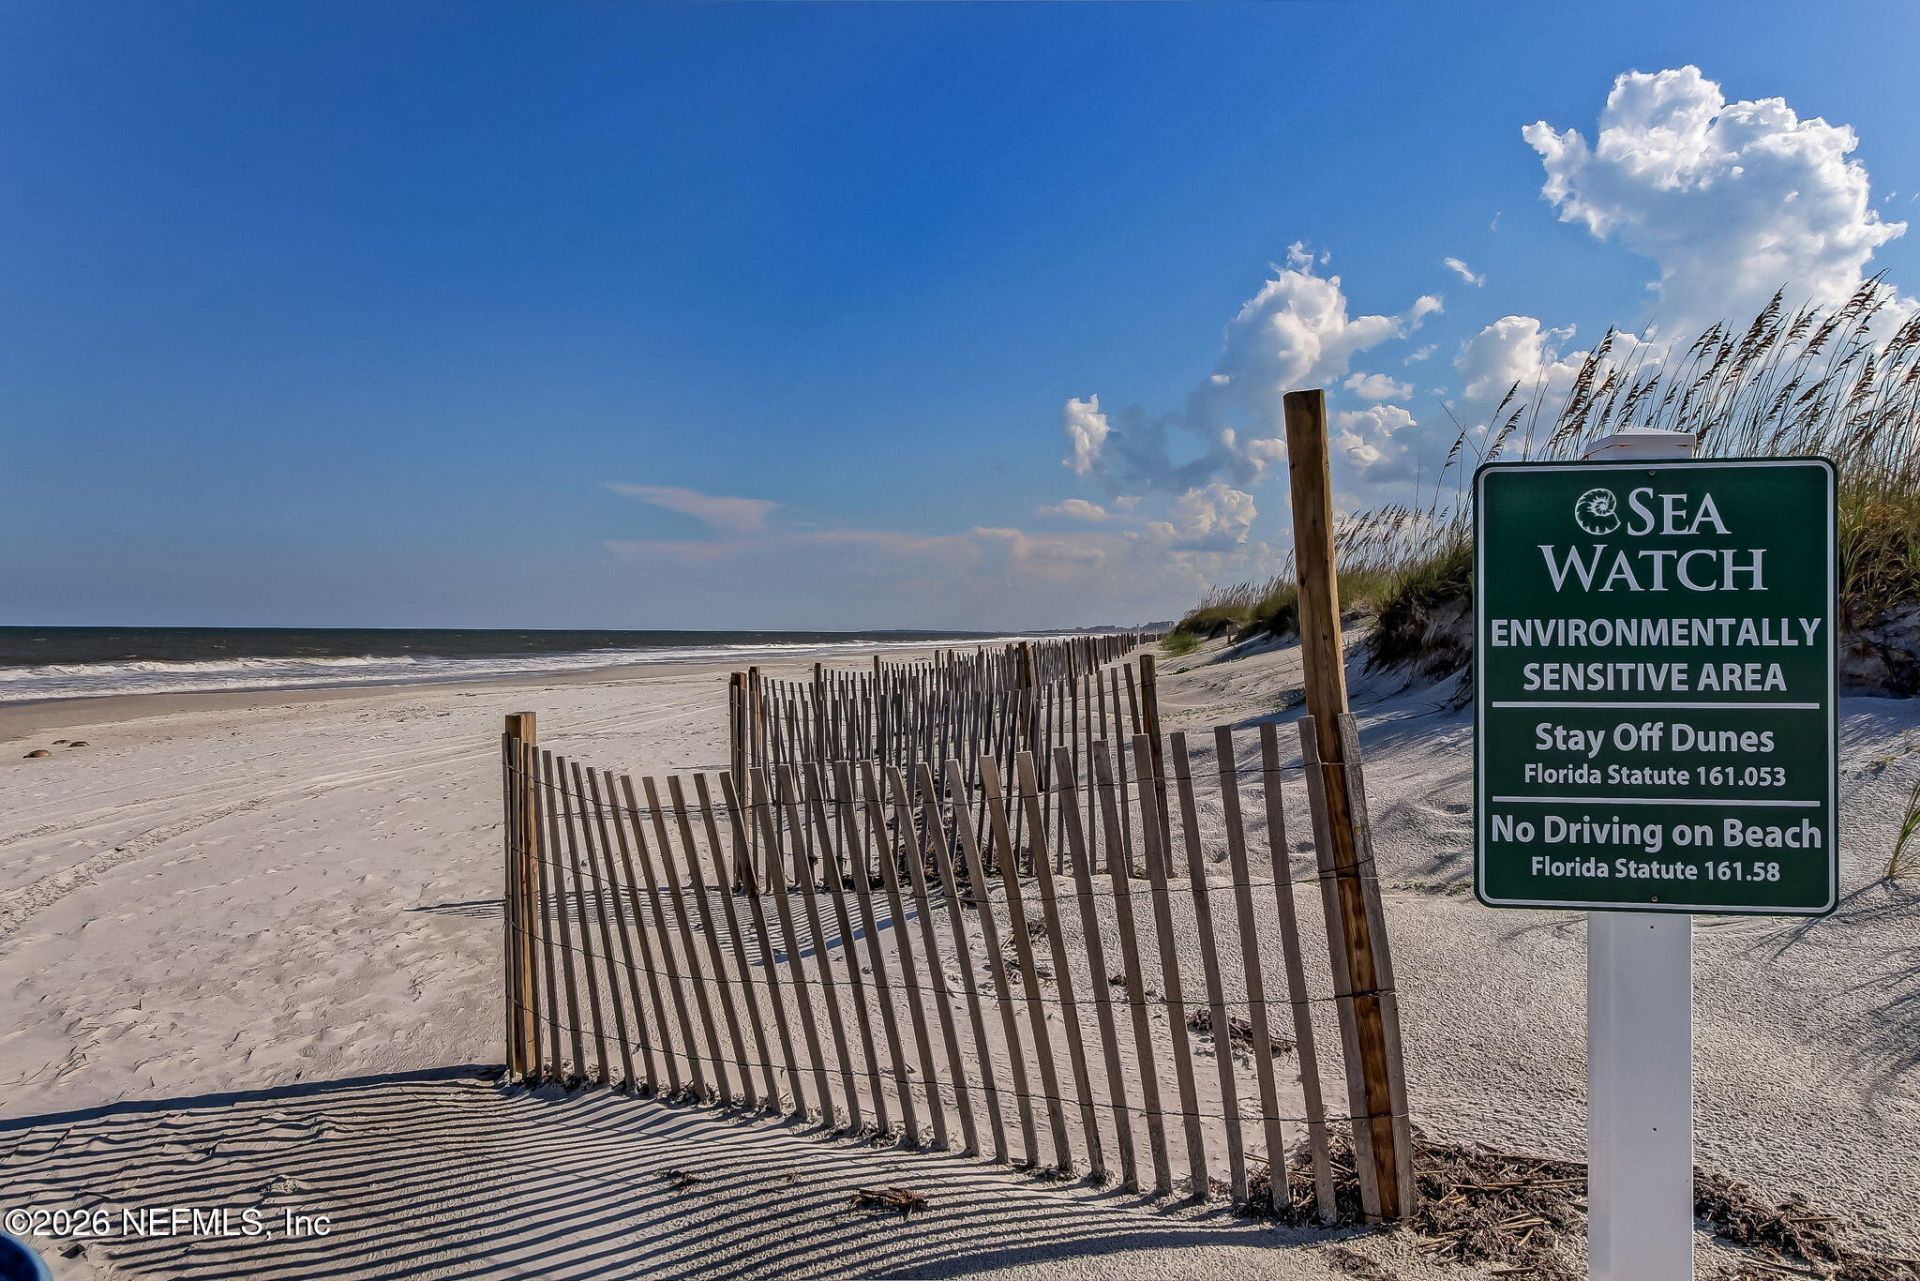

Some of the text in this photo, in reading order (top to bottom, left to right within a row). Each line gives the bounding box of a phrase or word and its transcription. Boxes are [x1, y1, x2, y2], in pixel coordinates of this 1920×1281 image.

[1628, 488, 1731, 536] SEA
[1538, 545, 1768, 592] WATCH
[1492, 618, 1821, 646] ENVIRONMENTALLY
[1524, 663, 1787, 691] SENSITIVE AREA
[1536, 722, 1774, 758] Stay Off Dunes
[1525, 763, 1785, 786] Florida Statute 161.053
[1492, 815, 1821, 853] No Driving on Beach
[1532, 856, 1780, 881] Florida Statute 161.58
